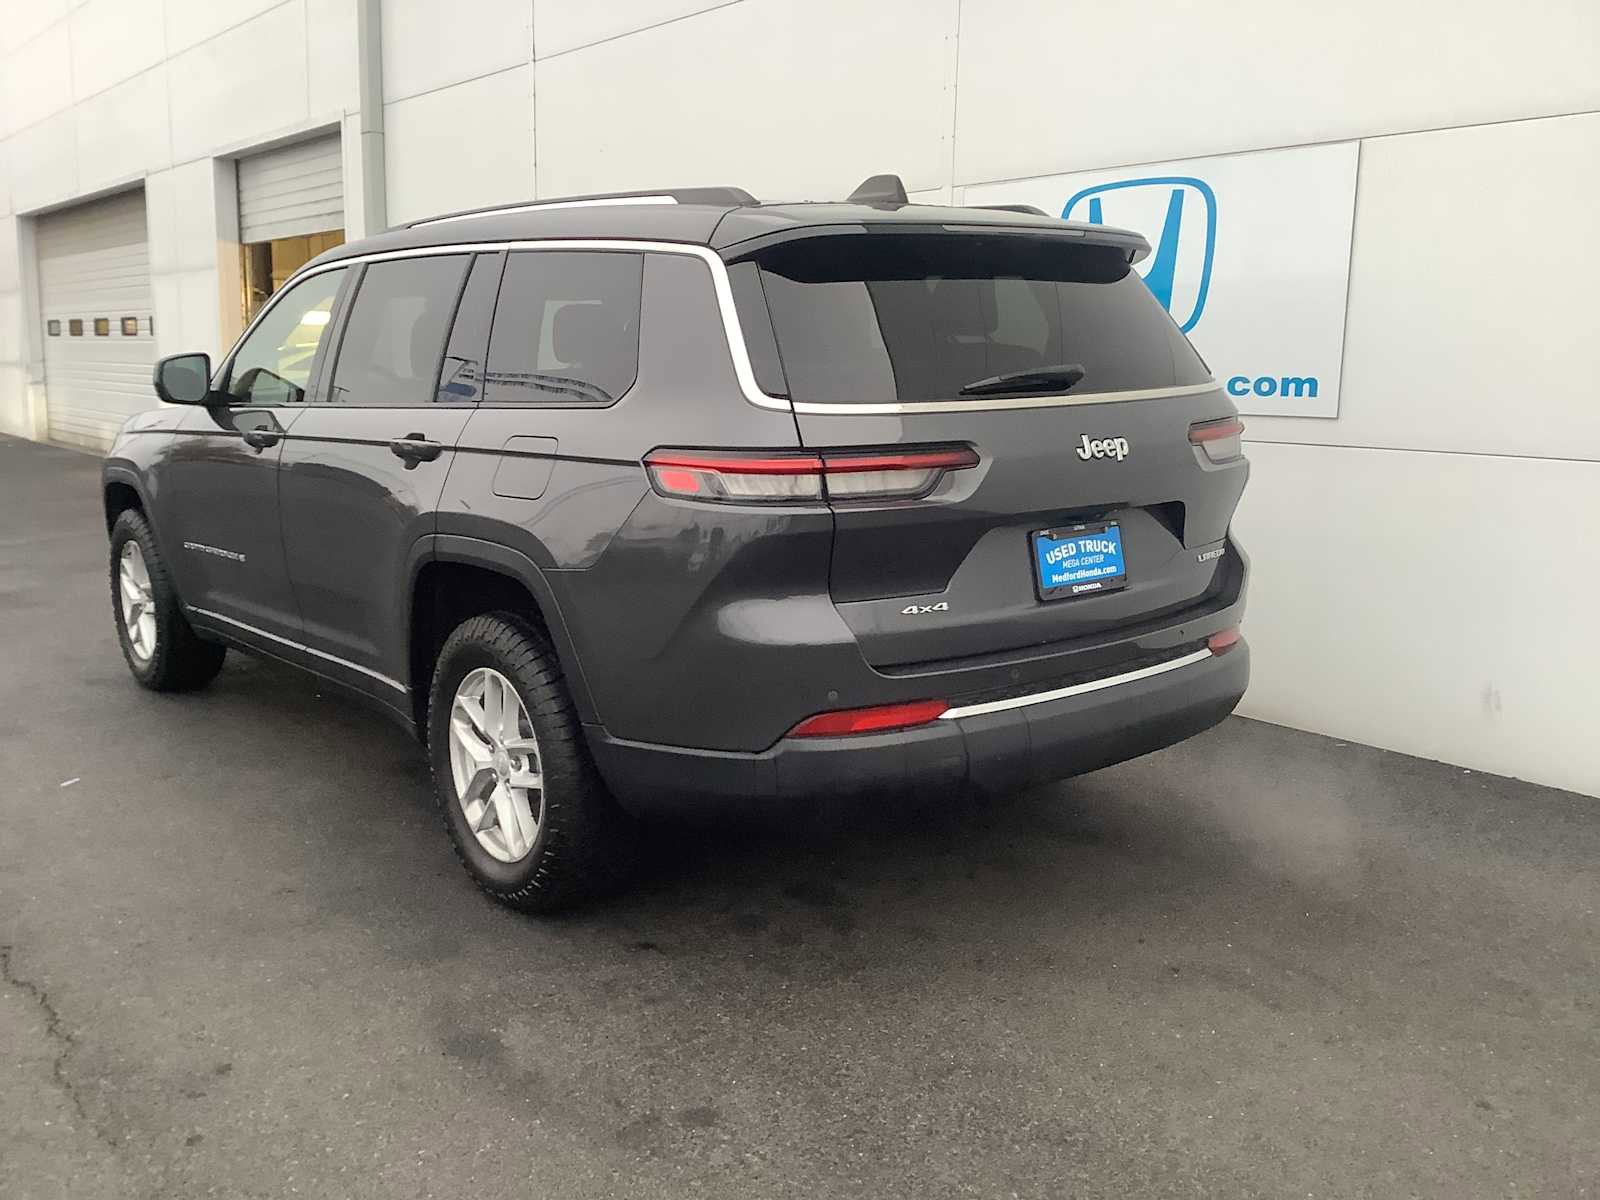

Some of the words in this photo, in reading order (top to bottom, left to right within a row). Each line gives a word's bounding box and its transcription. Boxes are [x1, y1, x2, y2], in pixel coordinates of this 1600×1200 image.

[1227, 376, 1318, 397] com
[1076, 434, 1129, 461] Jeep
[1046, 543, 1077, 565] USED
[1078, 539, 1117, 555] TRUCK
[1062, 558, 1080, 569] MEGA
[1080, 554, 1104, 566] CENTER
[1051, 565, 1117, 584] MedfordHonda.com
[901, 602, 949, 614] 4x4
